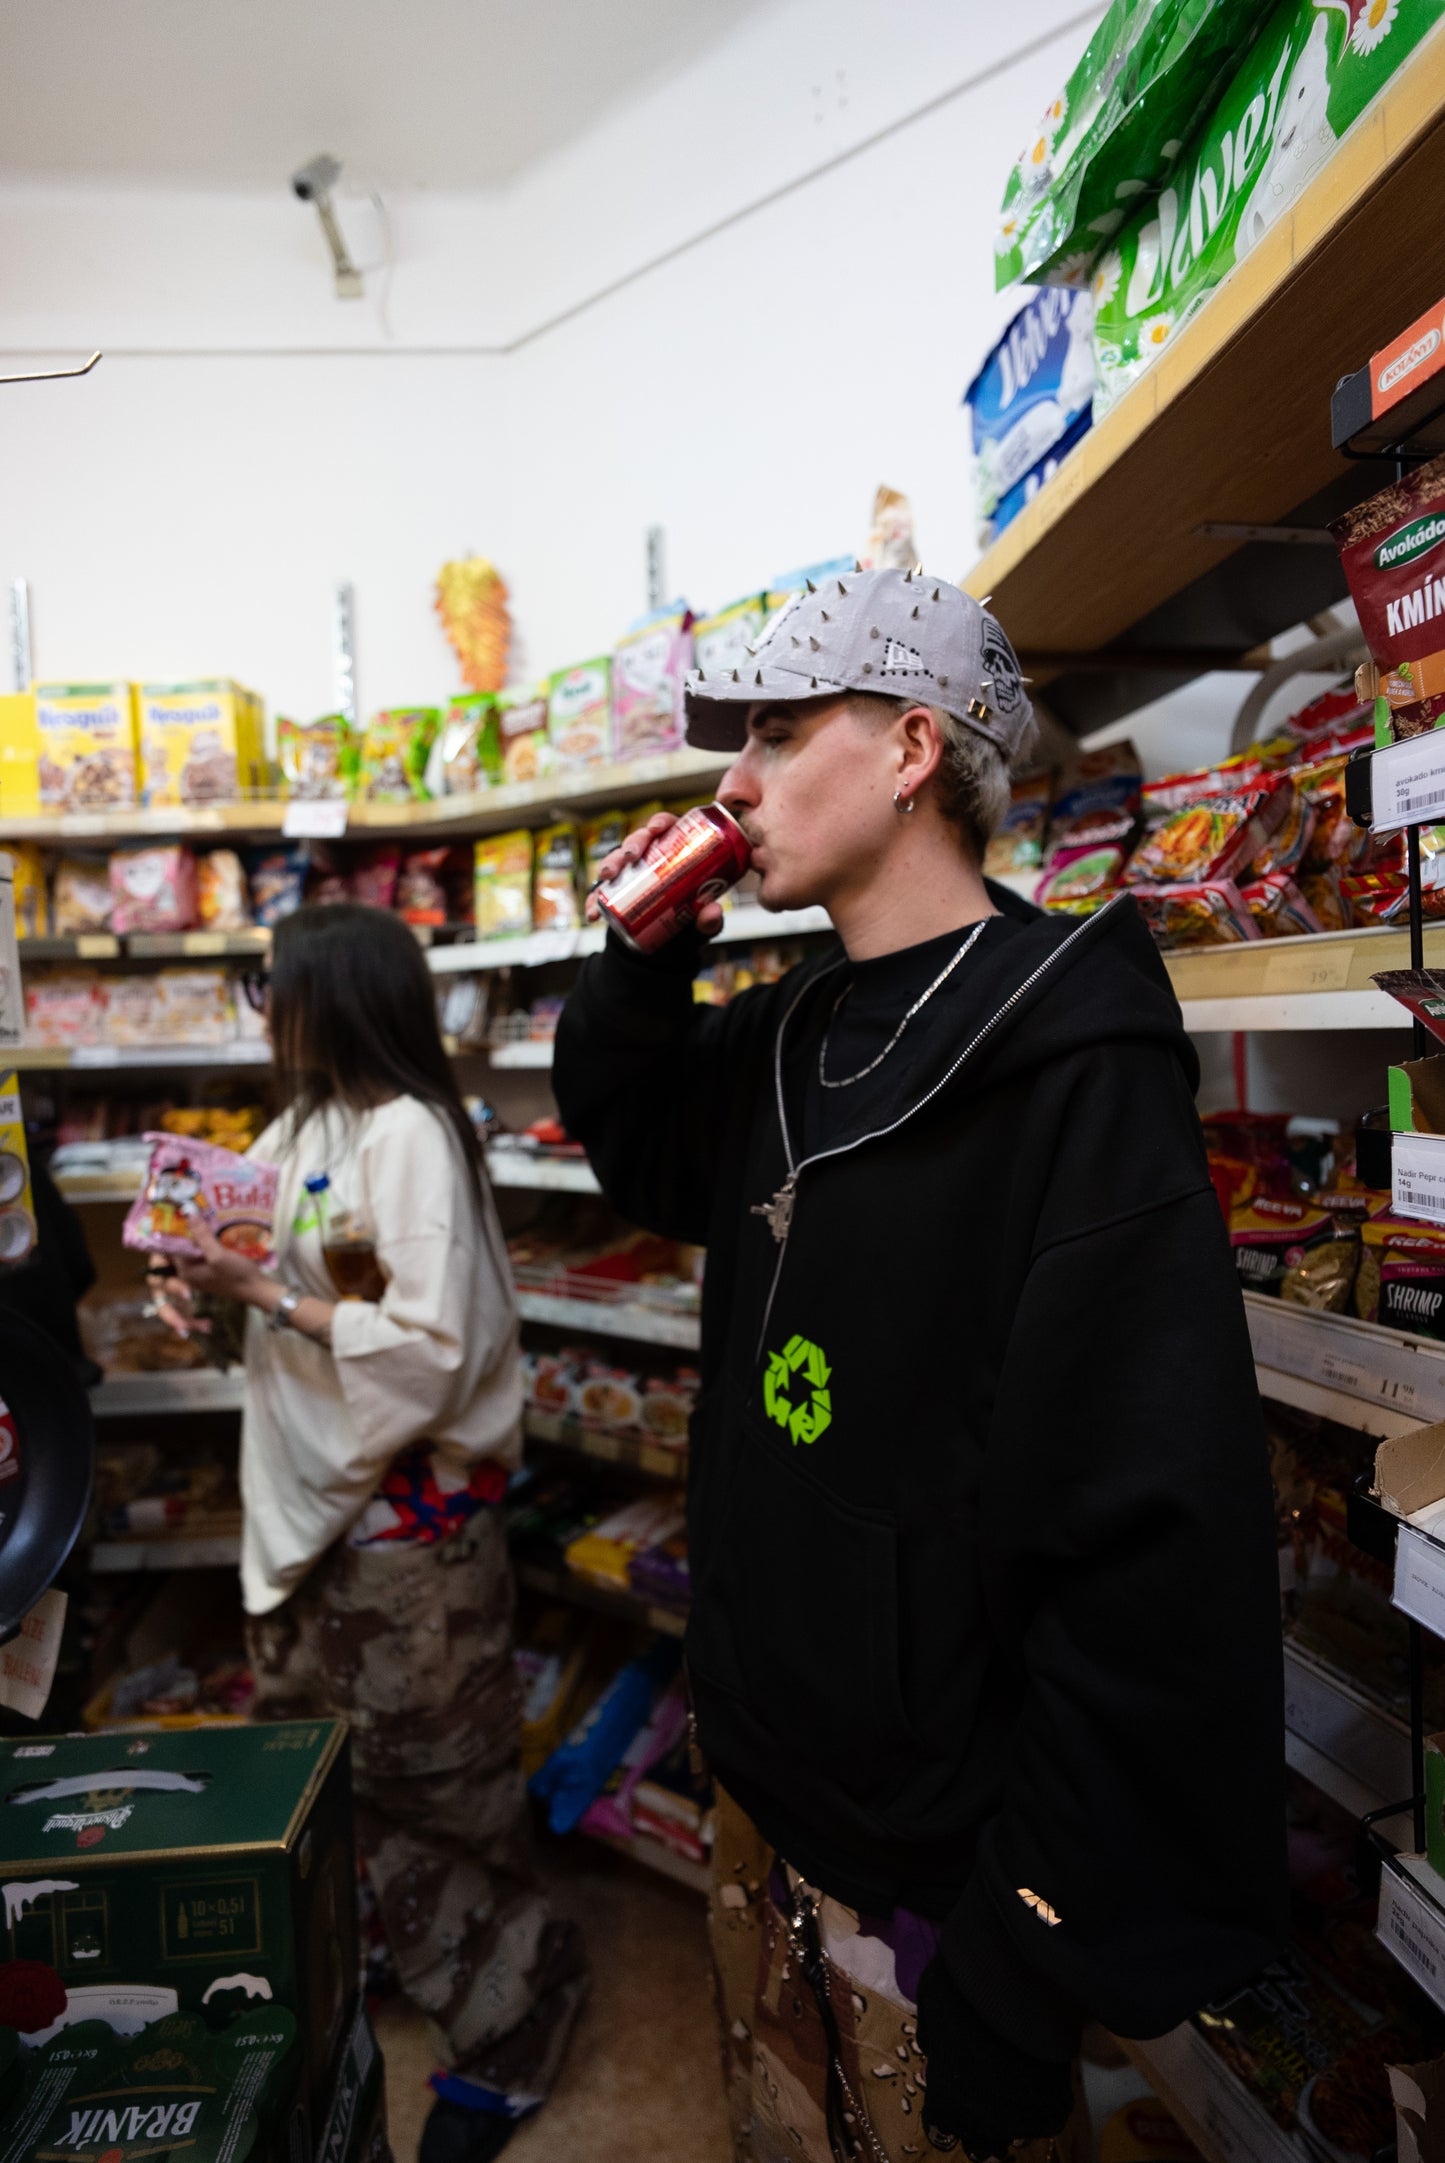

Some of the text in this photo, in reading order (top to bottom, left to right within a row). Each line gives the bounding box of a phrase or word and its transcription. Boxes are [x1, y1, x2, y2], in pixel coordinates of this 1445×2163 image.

[1379, 519, 1445, 568] Avokádo
[1395, 771, 1429, 787] avokado
[1235, 1246, 1278, 1277] SHRIMP
[1387, 1283, 1444, 1318] SHRIMP
[53, 2102, 202, 2151] BRANÍK
